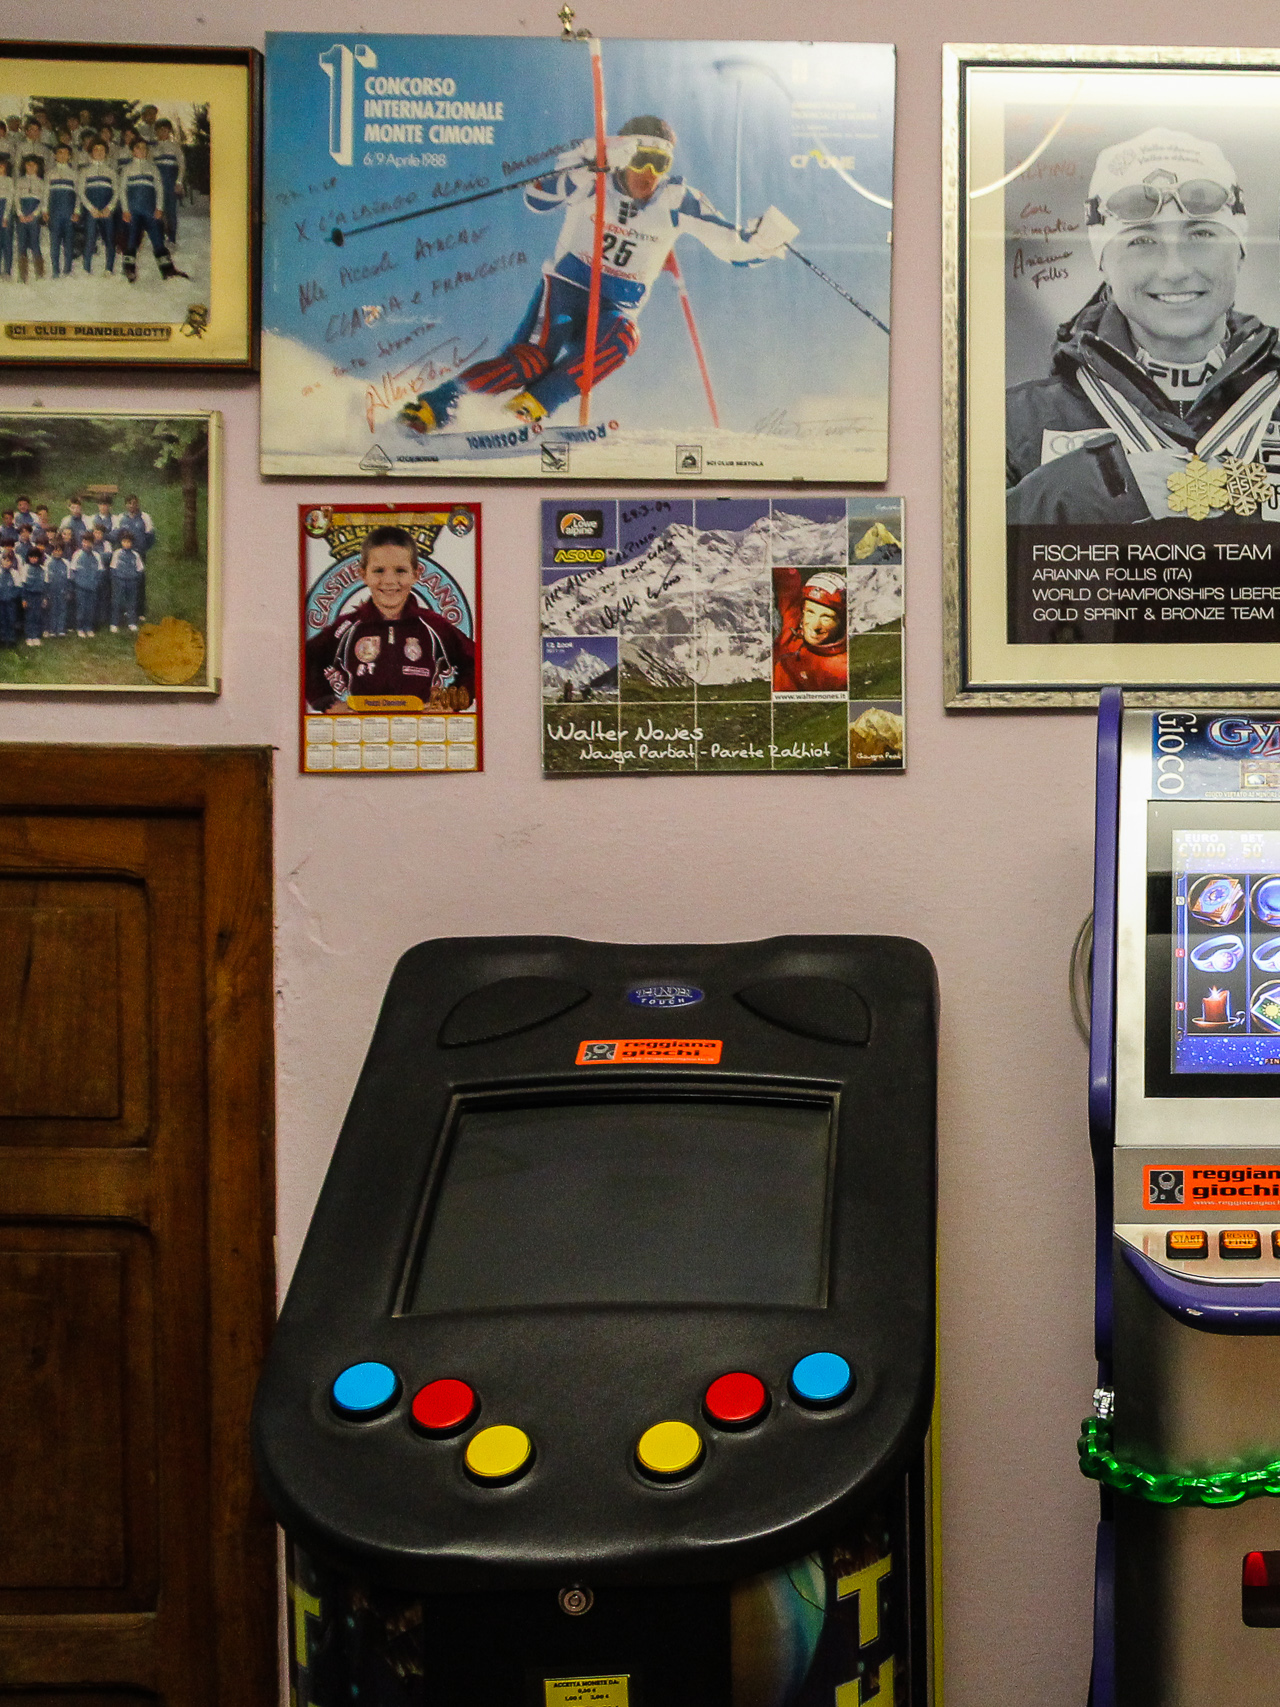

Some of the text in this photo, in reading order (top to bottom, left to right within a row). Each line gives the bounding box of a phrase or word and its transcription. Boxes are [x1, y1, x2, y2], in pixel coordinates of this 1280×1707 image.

[365, 77, 456, 97] CONCORSO
[364, 101, 504, 121] INTERNAZIONALE
[364, 124, 495, 145] MONTE CIMONE
[421, 153, 447, 167] 1988
[600, 232, 638, 267] 25
[34, 325, 67, 336] CLUB
[74, 325, 171, 337] PIANDELAGOTTI
[1150, 362, 1217, 388] FILA
[572, 518, 599, 529] Lowe
[565, 526, 595, 537] alpine
[553, 548, 607, 564] ASOLO
[1032, 544, 1272, 562] FISCHER RACING TEAM
[1032, 567, 1192, 582] ARIANNA FOLLIS (ITA)
[1032, 588, 1091, 601] WORLD
[1097, 587, 1225, 601] CHAMPIONSHIPS
[1032, 607, 1078, 622] GOLD
[1084, 607, 1138, 621] SPRINT
[1144, 608, 1156, 621] &
[1161, 607, 1225, 621] BRONZE
[1231, 607, 1275, 620] TEAM
[774, 692, 847, 701] www.walternones.it
[546, 719, 705, 742] Walter Nones
[638, 744, 695, 760] Parbat
[710, 744, 765, 760] Parete
[769, 741, 831, 759] Rakhiot
[1184, 834, 1219, 843] EURO
[1240, 834, 1264, 843] BET
[1192, 843, 1227, 858] 0.00
[1242, 843, 1262, 858] 50
[624, 1041, 717, 1049] reggiana
[1192, 1183, 1280, 1200] giochi
[1172, 1234, 1202, 1244] START
